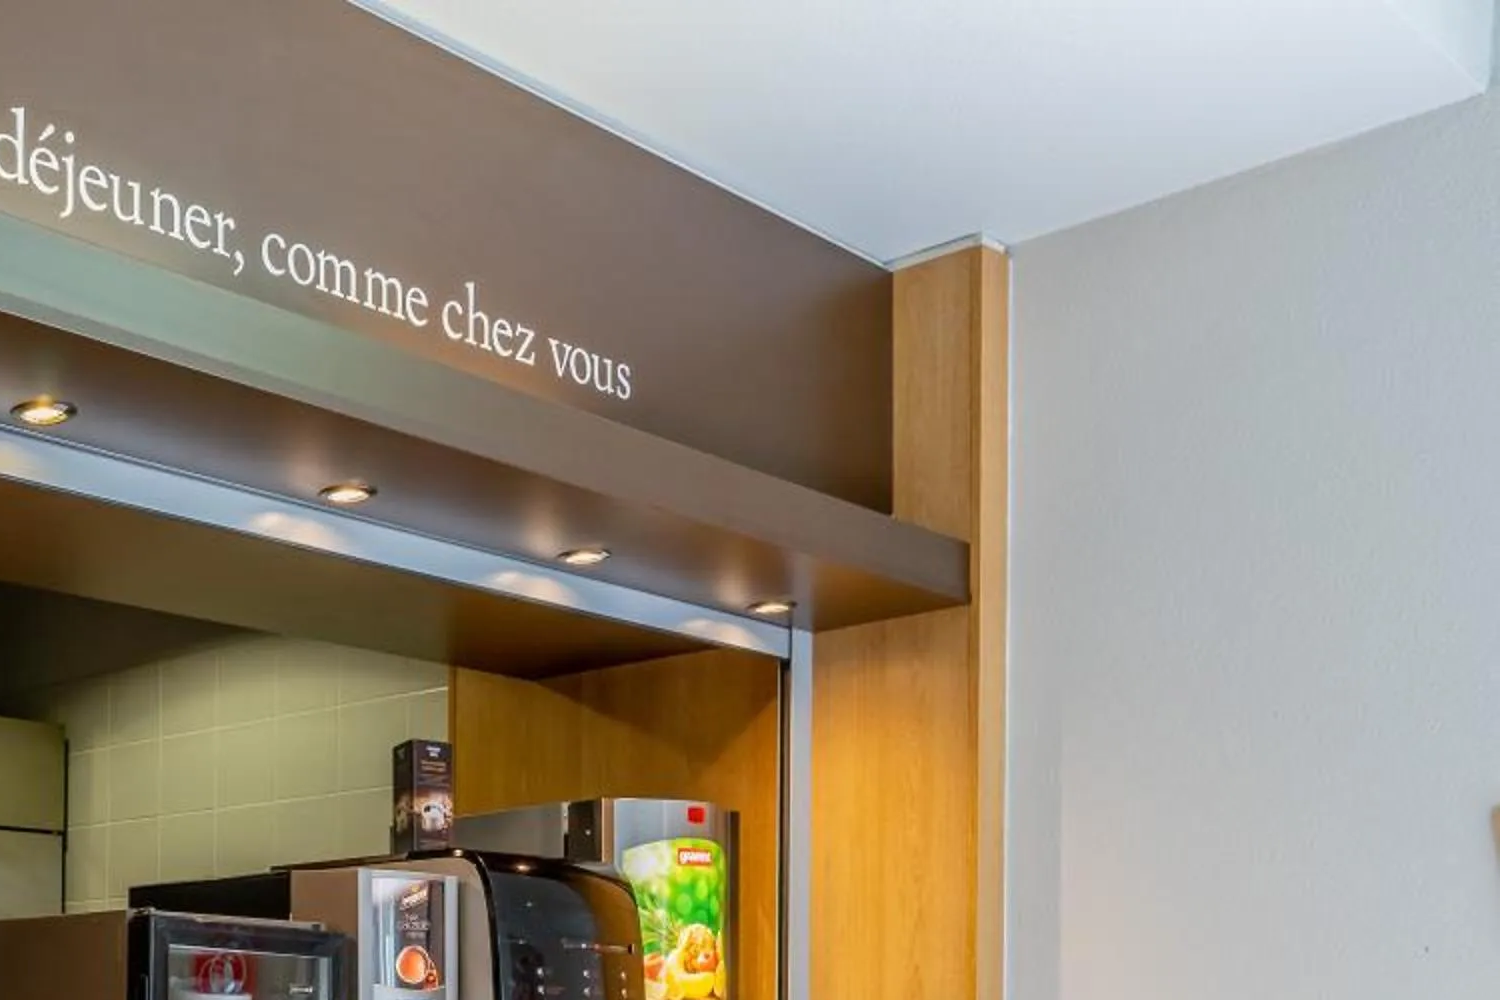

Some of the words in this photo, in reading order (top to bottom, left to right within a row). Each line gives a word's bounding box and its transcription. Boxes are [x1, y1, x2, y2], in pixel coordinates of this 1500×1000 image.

[261, 232, 430, 328] comme
[441, 281, 536, 366] chez
[547, 337, 632, 399] vous
